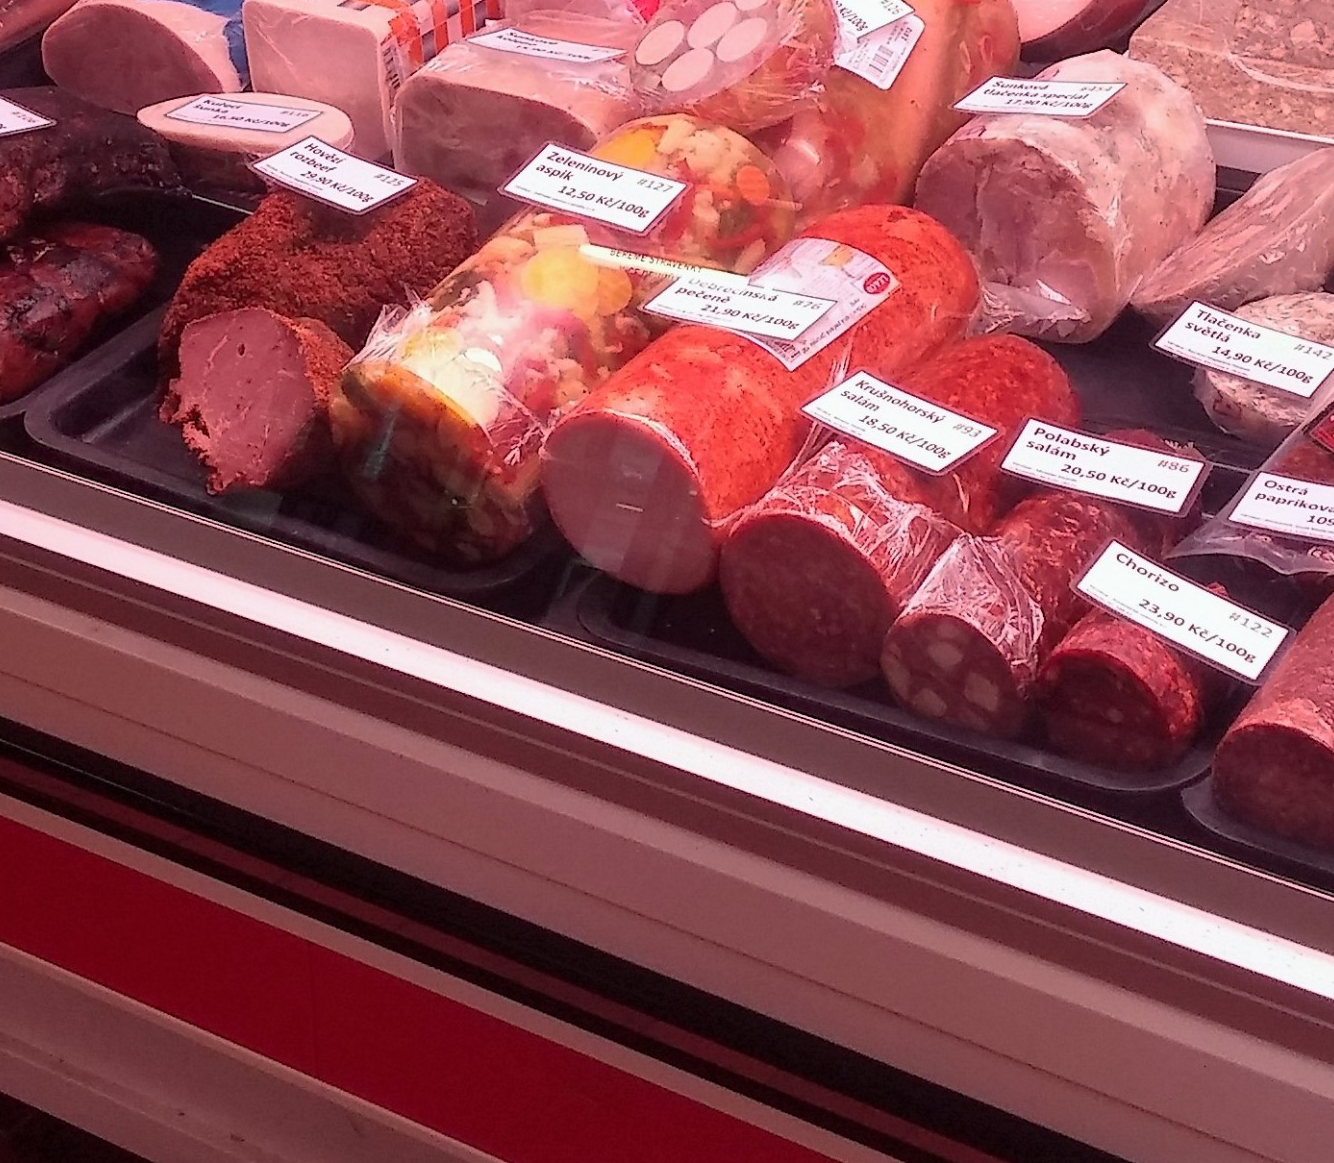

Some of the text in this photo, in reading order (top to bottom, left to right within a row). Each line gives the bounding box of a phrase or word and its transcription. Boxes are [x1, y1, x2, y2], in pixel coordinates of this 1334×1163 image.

[546, 151, 674, 193] Zeleninový #127
[331, 181, 375, 204] Kč/100g
[558, 185, 651, 219] 12,50 Kč/100g
[675, 286, 731, 304] pečeně
[741, 312, 800, 331] Kč/100g
[1184, 320, 1230, 344] světlá
[1196, 309, 1262, 339] Tlačenka
[1212, 345, 1314, 385] 14,90 Kč/100g
[840, 389, 880, 413] salám
[854, 379, 983, 439] Krušnohorský #93
[858, 414, 952, 460] 18,50 Kč/100g
[1025, 439, 1077, 461] salám
[1034, 426, 1190, 474] Polabský #86
[1061, 463, 1178, 500] 20,50 Kč/100g
[1264, 479, 1310, 497] Ostrá
[1116, 552, 1273, 638] Chorizo #122
[1138, 598, 1257, 664] 23,90 Kč/100g
